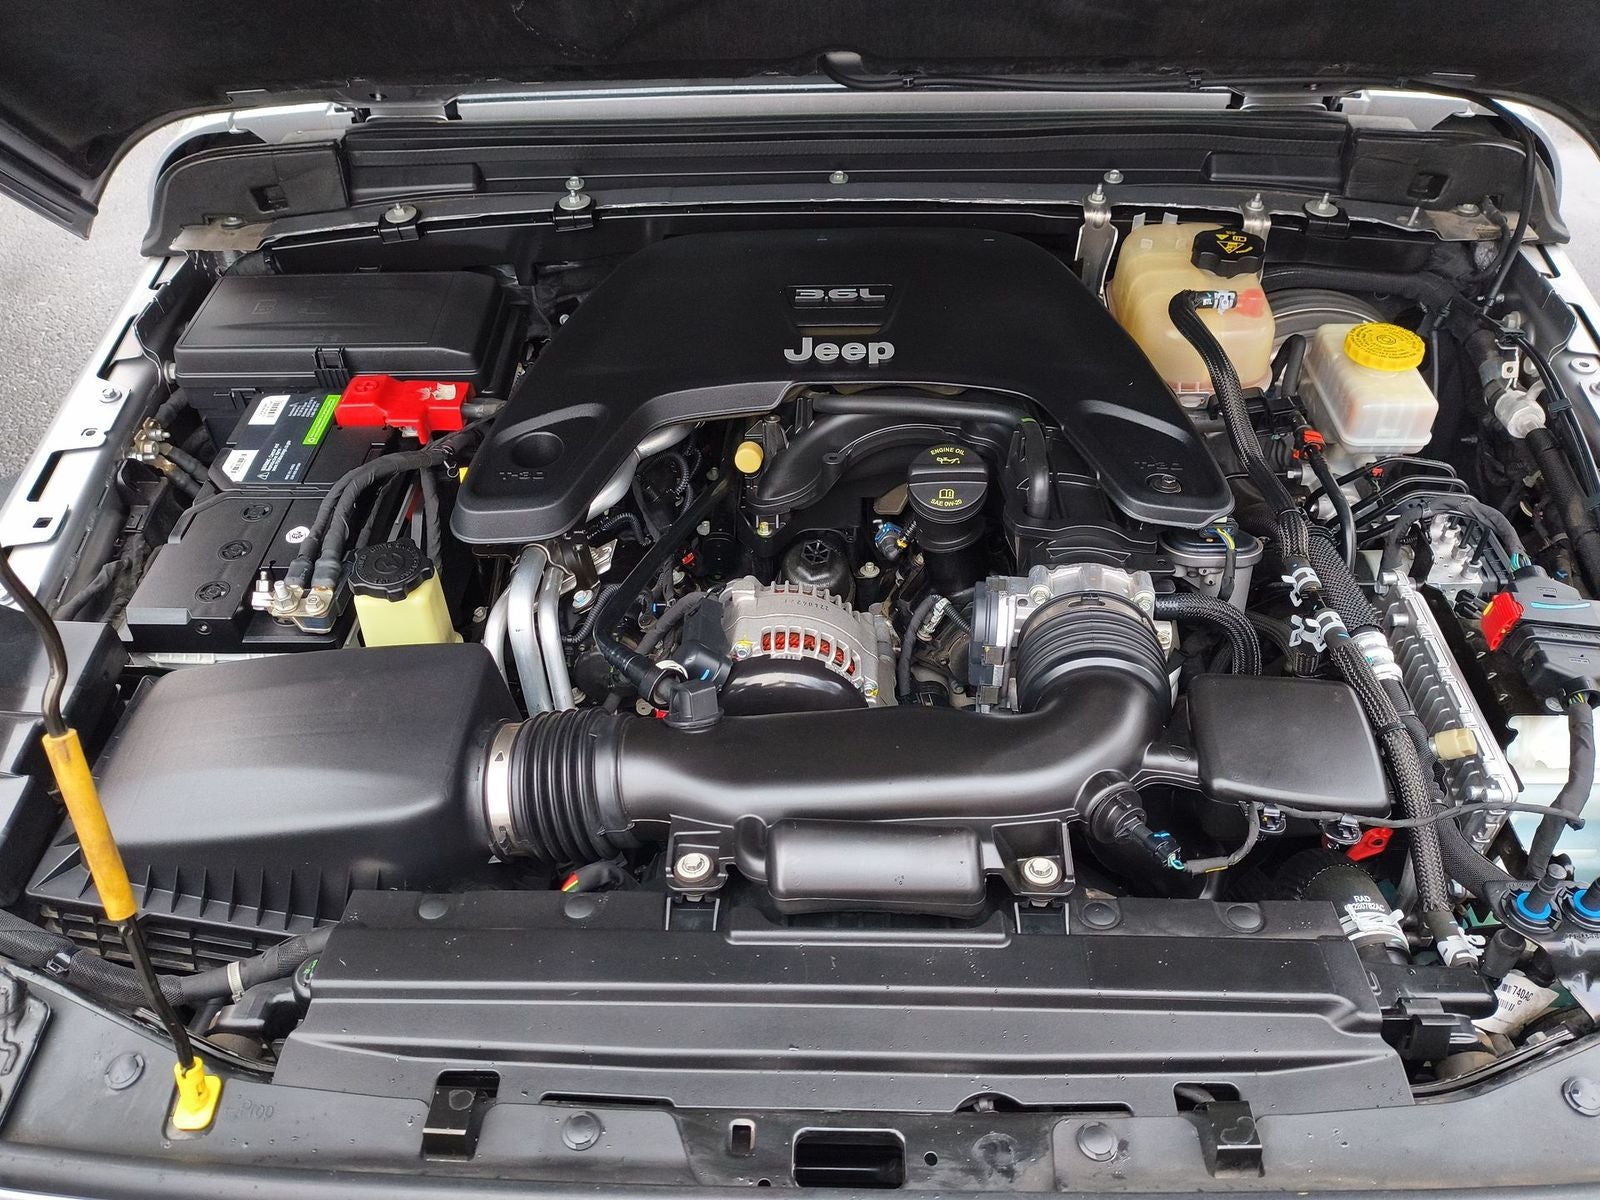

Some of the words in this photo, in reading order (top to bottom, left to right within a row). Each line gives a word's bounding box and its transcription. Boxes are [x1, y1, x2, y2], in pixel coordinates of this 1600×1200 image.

[794, 288, 886, 302] 3.6L
[784, 337, 895, 366] Jeep
[930, 447, 955, 456] ENGINE
[955, 448, 965, 456] OIL
[930, 499, 943, 507] SAE
[1353, 895, 1371, 903] RAD
